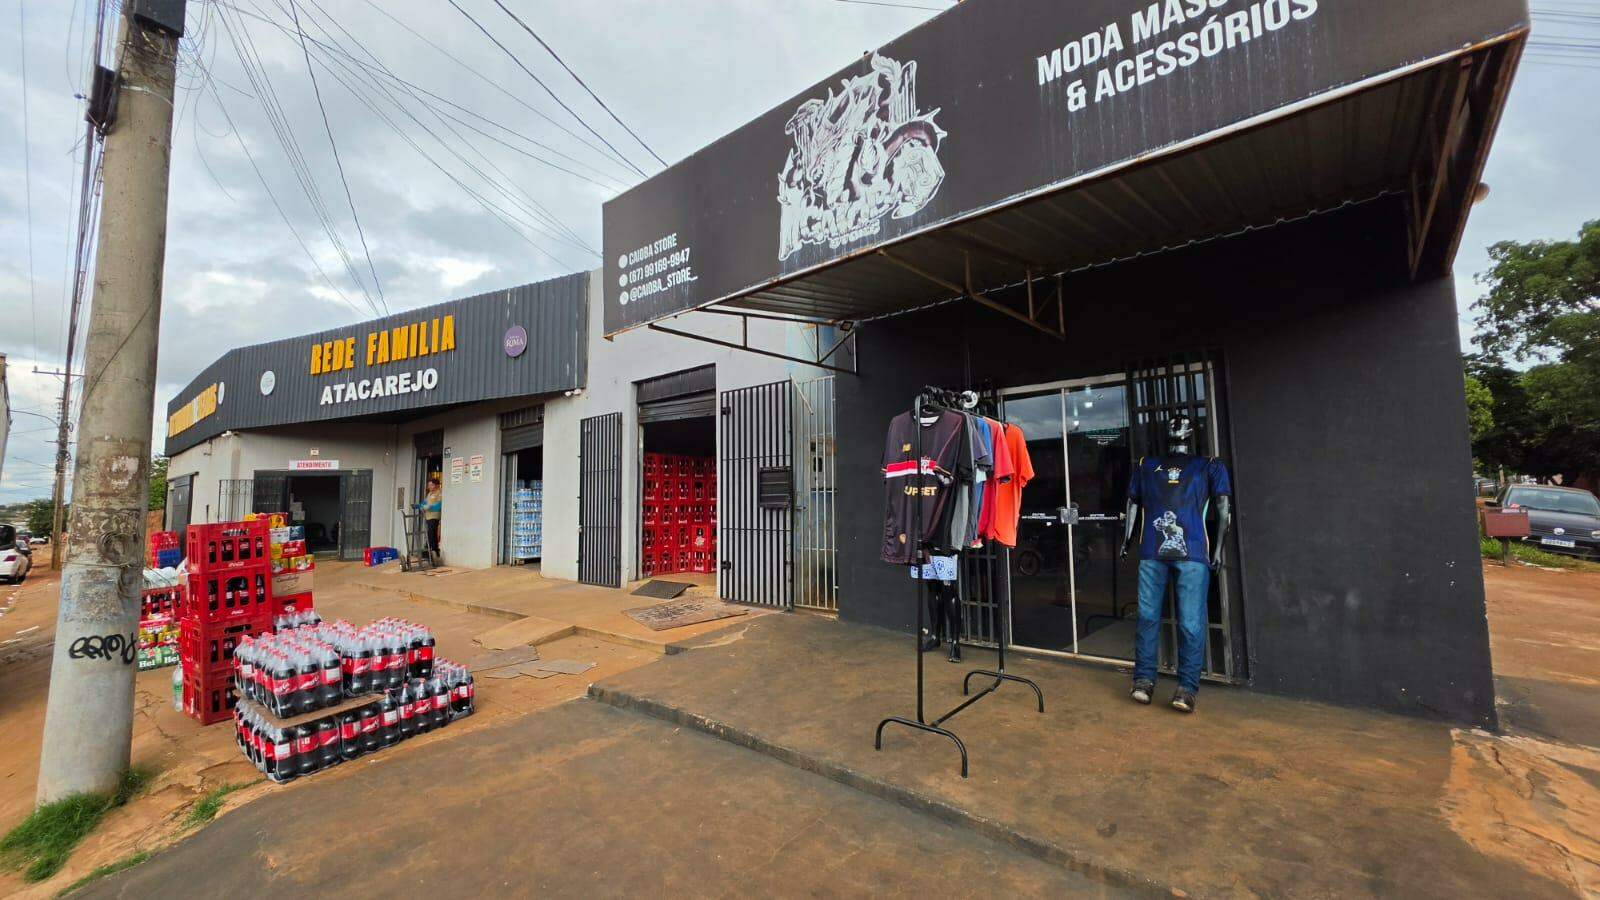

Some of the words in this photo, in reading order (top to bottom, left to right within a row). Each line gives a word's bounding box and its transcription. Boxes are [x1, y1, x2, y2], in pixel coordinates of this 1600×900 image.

[1037, 22, 1124, 86] MODA
[1131, 0, 1229, 44] MAS
[1066, 79, 1087, 113] &
[1094, 0, 1319, 103] ACESSÓRIOS
[628, 244, 654, 266] CAIOBA
[654, 232, 678, 255] STORE
[629, 267, 644, 284] (67)
[310, 336, 356, 376] REDE
[366, 315, 456, 367] FAMILIA
[320, 367, 439, 406] ATACAREJO
